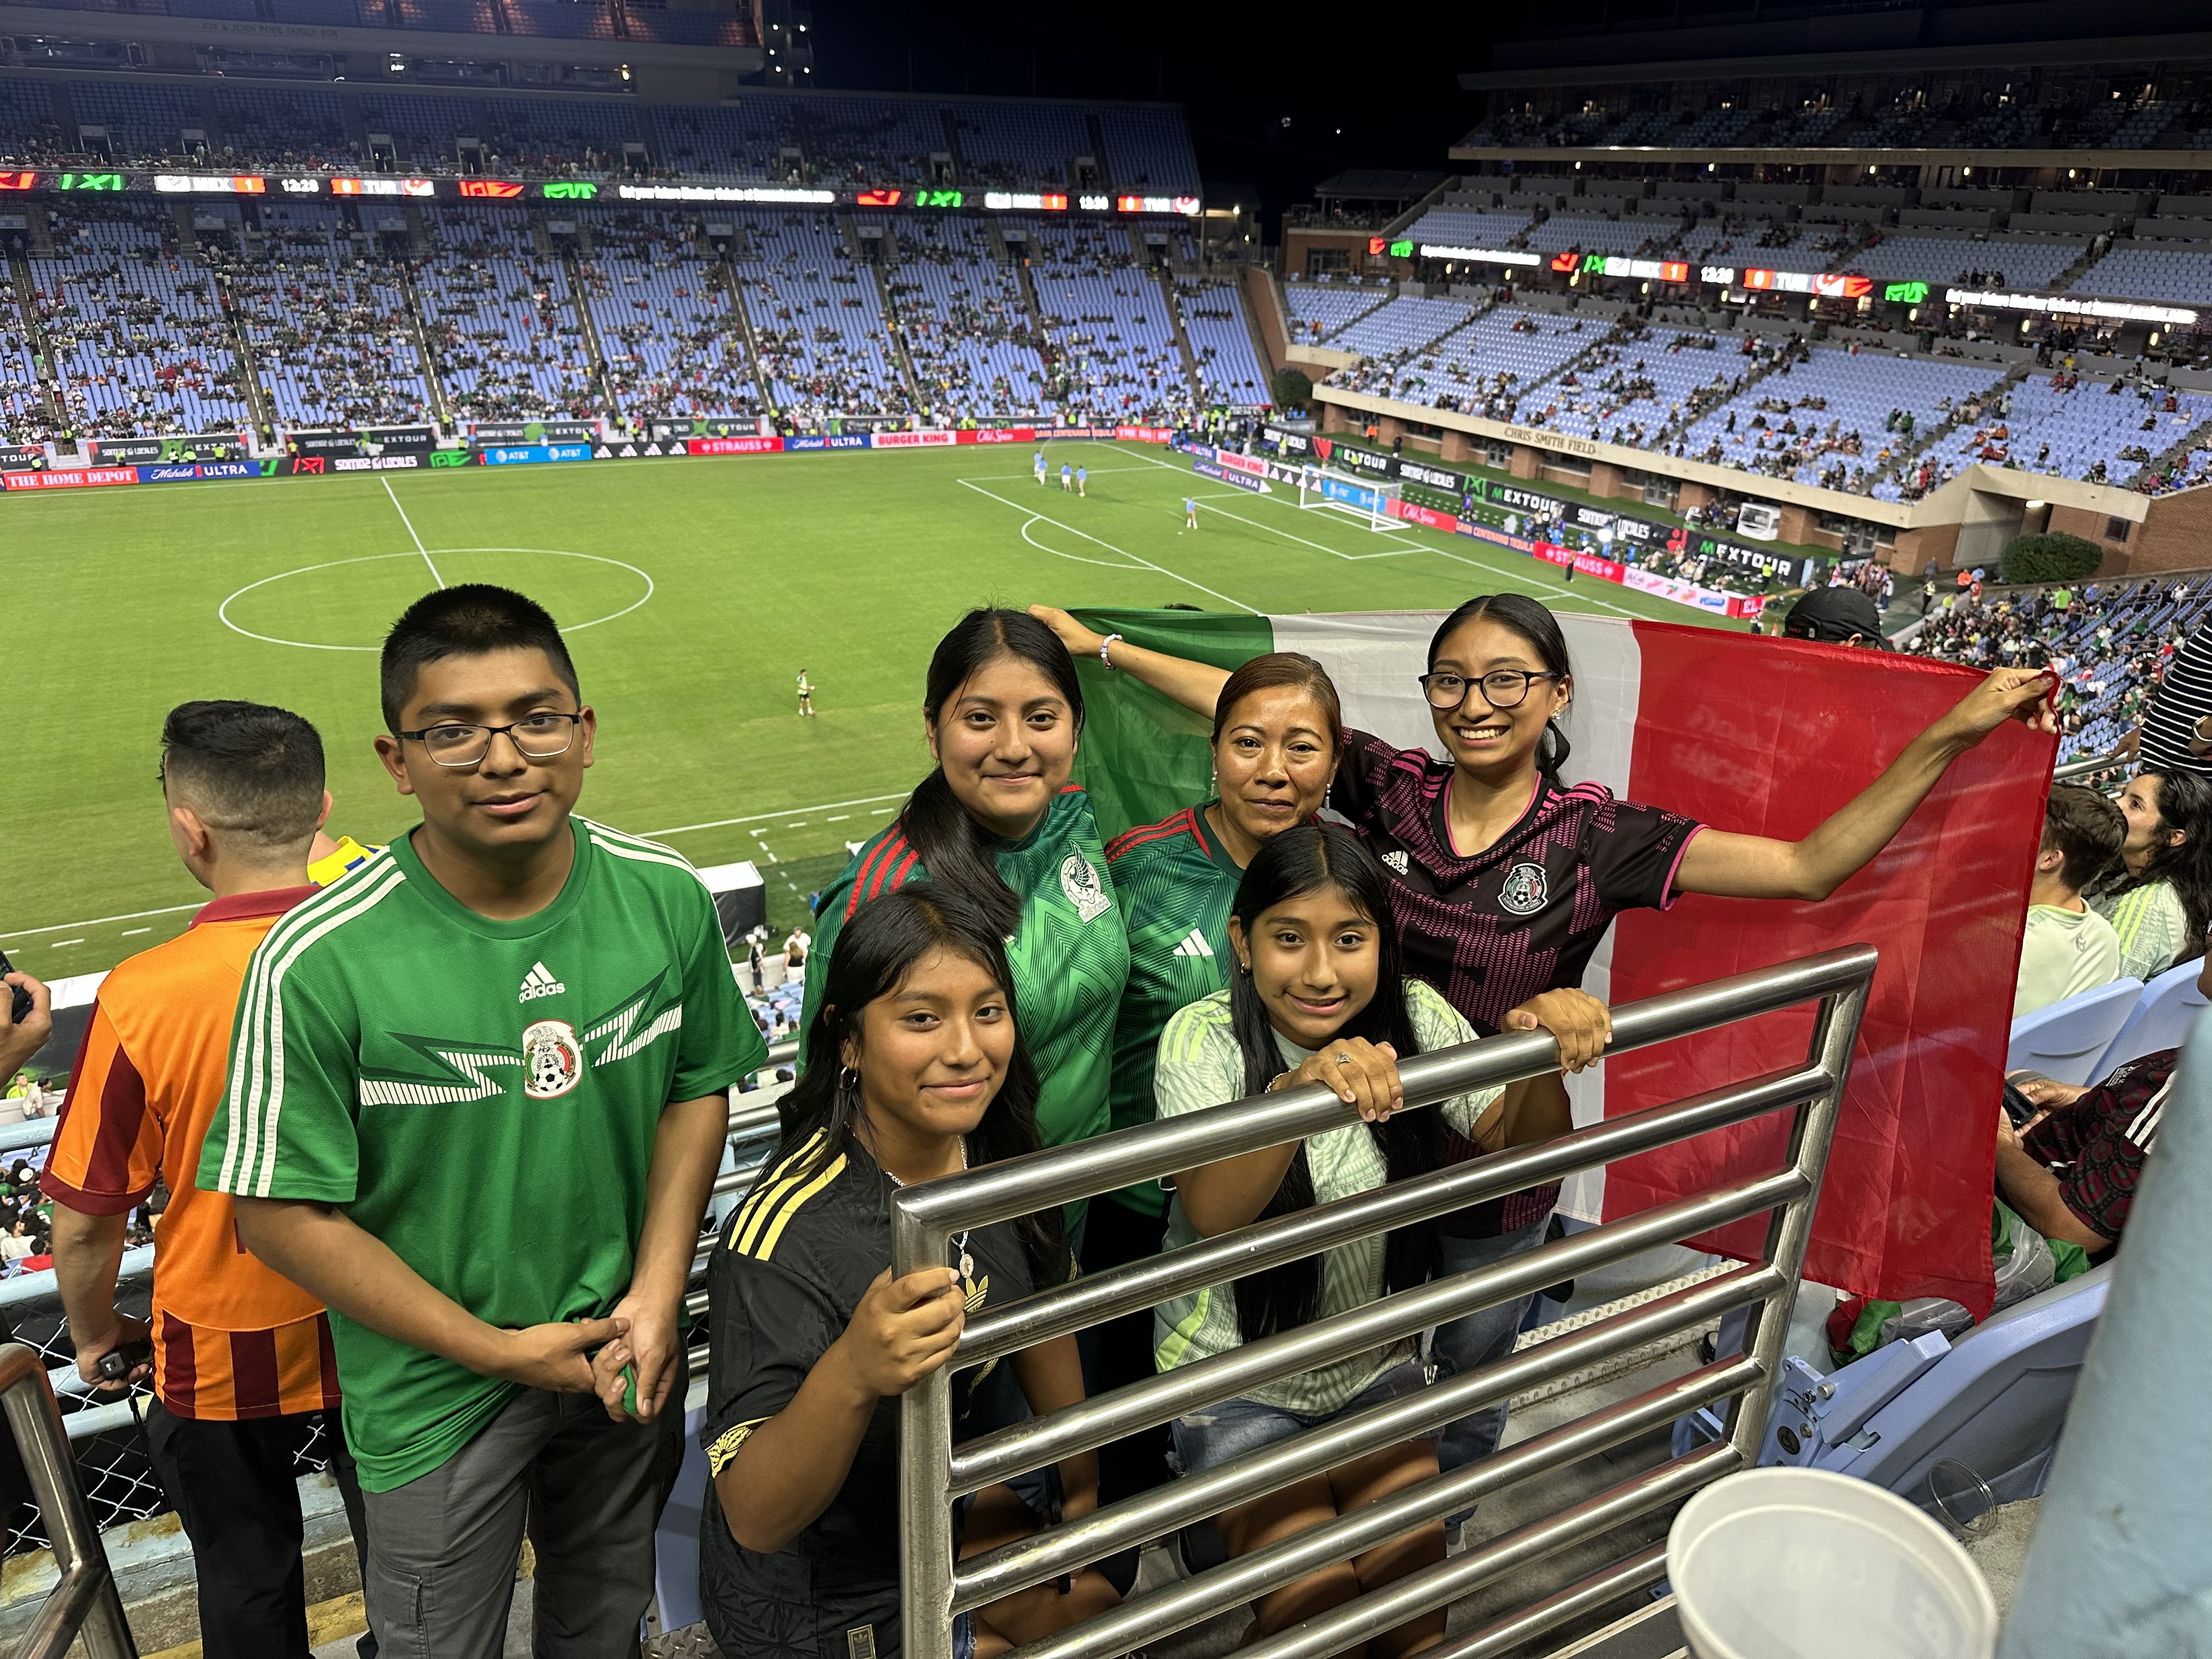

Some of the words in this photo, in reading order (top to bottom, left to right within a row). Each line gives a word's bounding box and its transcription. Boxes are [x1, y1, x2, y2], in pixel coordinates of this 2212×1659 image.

[245, 179, 253, 190] 1
[364, 182, 396, 194] TUR
[1671, 264, 1678, 278] 1
[831, 436, 863, 447] ULTRA
[878, 435, 921, 445] BURGER
[923, 433, 949, 444] KING
[1504, 426, 1532, 440] CHRIS
[1534, 432, 1565, 447] SMITH
[1568, 440, 1596, 454] FIELD
[561, 448, 582, 458] AT&T
[712, 441, 761, 453] STRAUSS
[508, 450, 529, 460] AT&T
[204, 464, 248, 477] ULTRA
[8, 474, 38, 488] THE
[43, 472, 84, 486] HOME
[87, 469, 133, 483] DEPOT
[1228, 472, 1259, 488] ULTRA
[1554, 550, 1602, 575] STAUSS
[1381, 854, 1408, 876] adidas
[519, 983, 566, 1004] adidas
